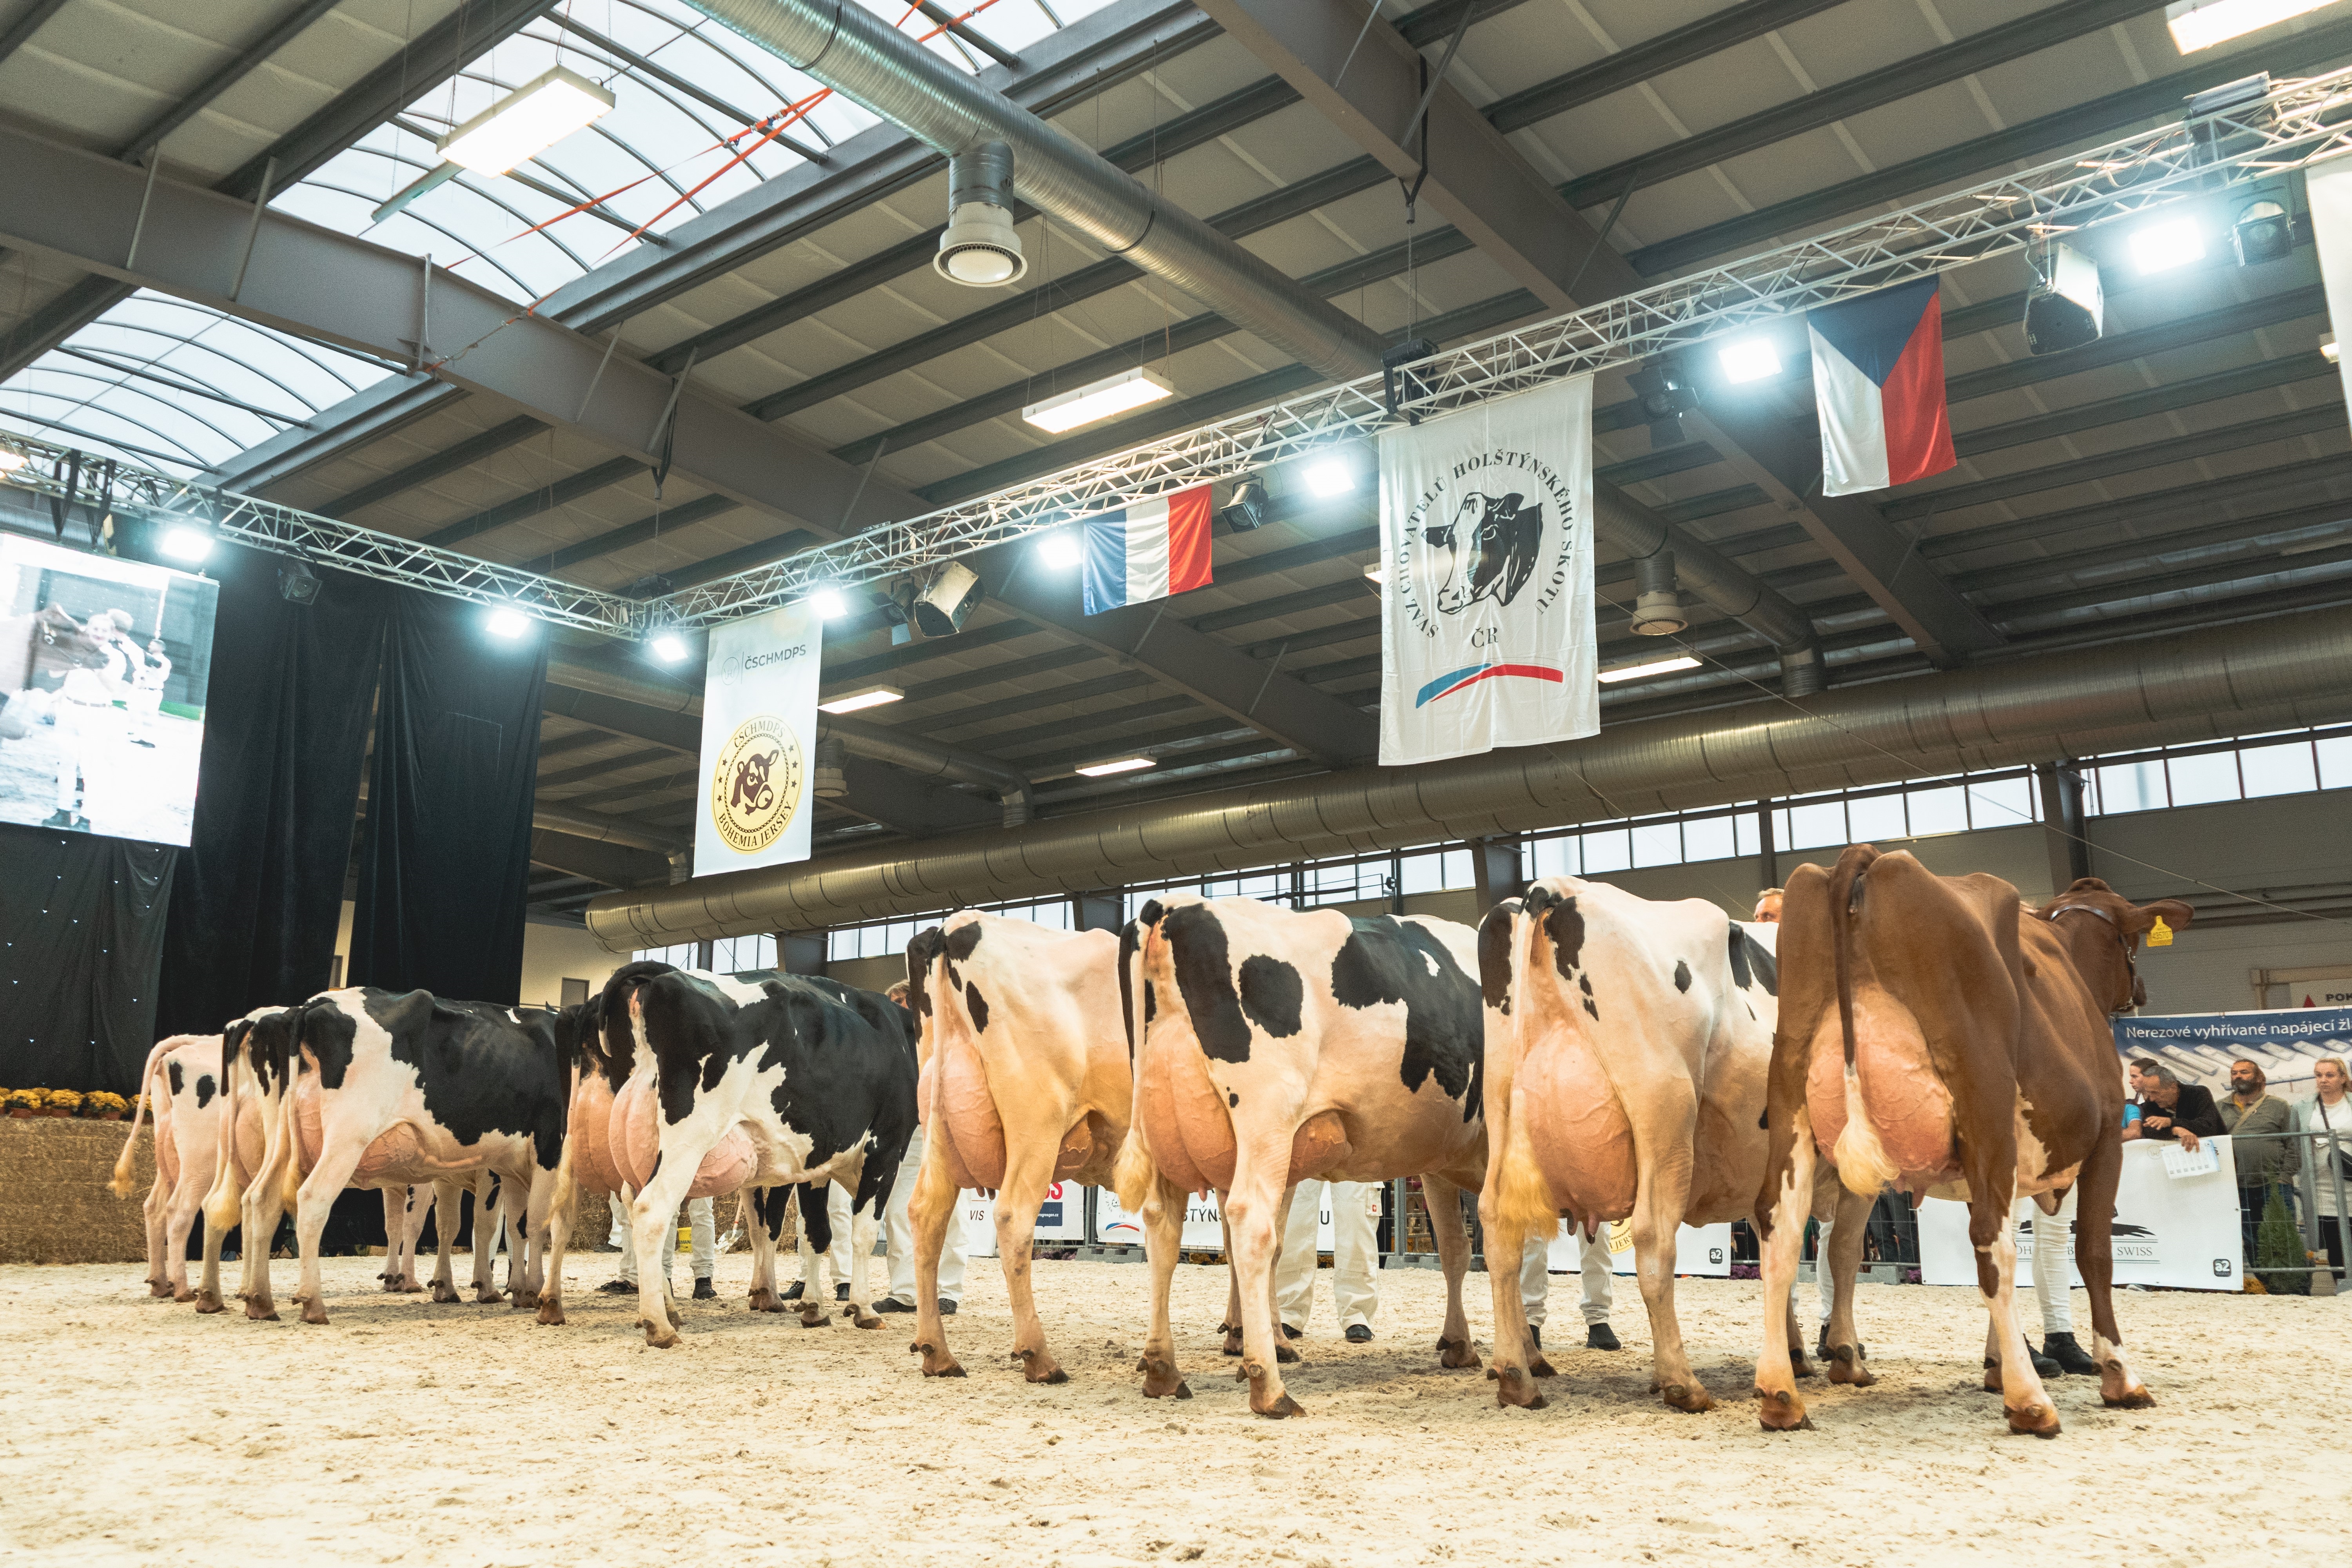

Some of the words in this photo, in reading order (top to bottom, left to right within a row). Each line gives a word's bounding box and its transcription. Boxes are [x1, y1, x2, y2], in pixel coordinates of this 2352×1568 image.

[1453, 448, 1573, 530] HOLŠTÝNSKÉHO
[1399, 476, 1447, 593] CHOVATELŮ
[1535, 541, 1572, 615] SKOTU
[1405, 599, 1439, 638] SVAZ
[1472, 627, 1498, 648] ČR
[745, 644, 806, 670] ČSCHMDPS
[734, 720, 785, 748] ČSCHMDPS
[719, 813, 757, 847] BOHEMIA
[760, 801, 792, 846] JERSEY
[2127, 1025, 2190, 1038] Nerezové
[2194, 1023, 2267, 1039] vyhřívané
[2271, 1019, 2334, 1036] napájecí
[2338, 1018, 2352, 1030] žl
[2117, 1247, 2152, 1256] SWISS
